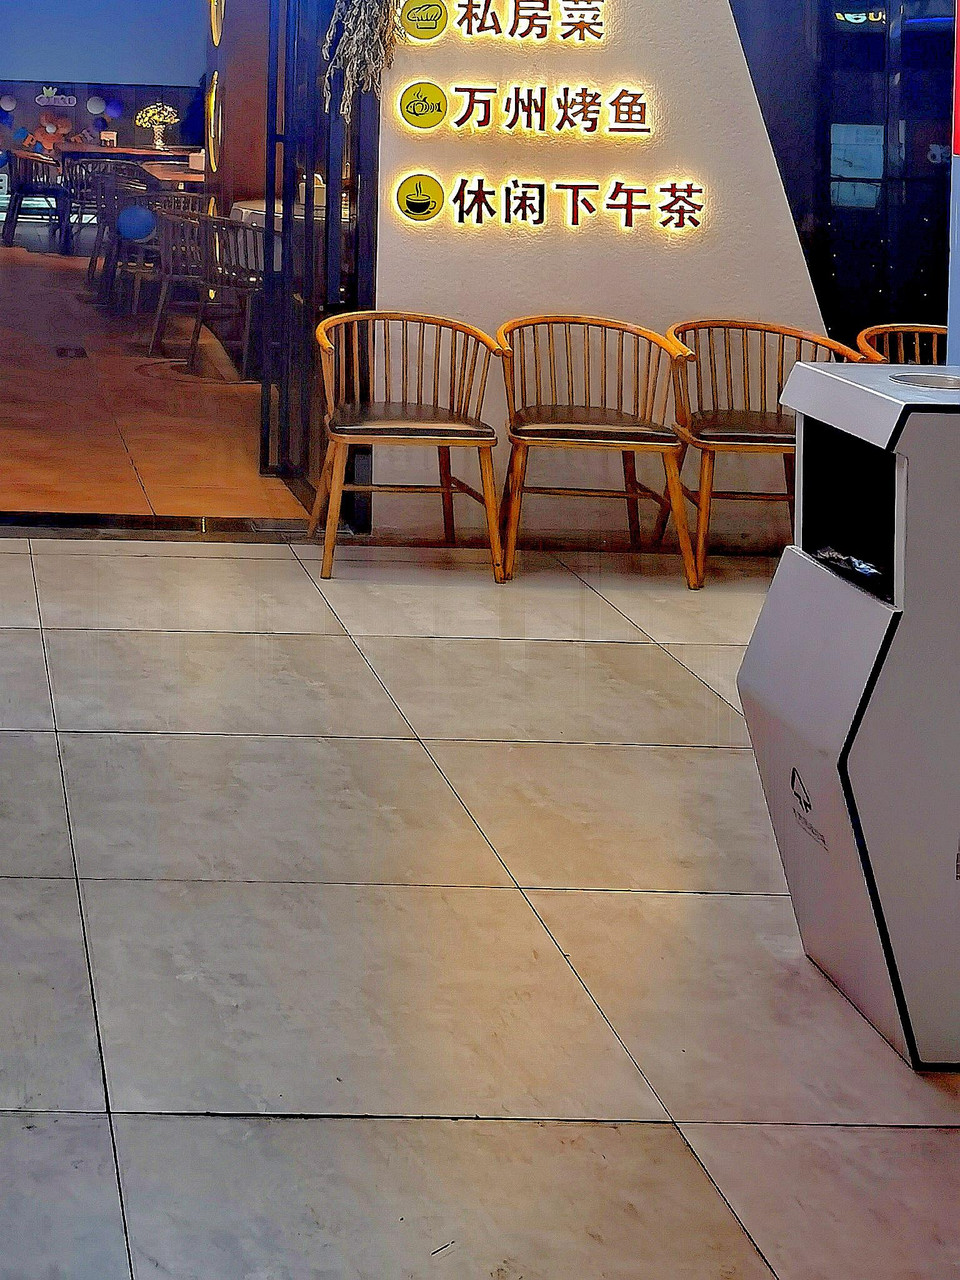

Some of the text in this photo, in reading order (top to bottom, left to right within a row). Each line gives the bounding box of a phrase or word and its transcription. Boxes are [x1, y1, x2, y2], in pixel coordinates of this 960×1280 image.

[454, 86, 651, 133] 万州烤鱼
[452, 178, 704, 228] 休闲下午茶
